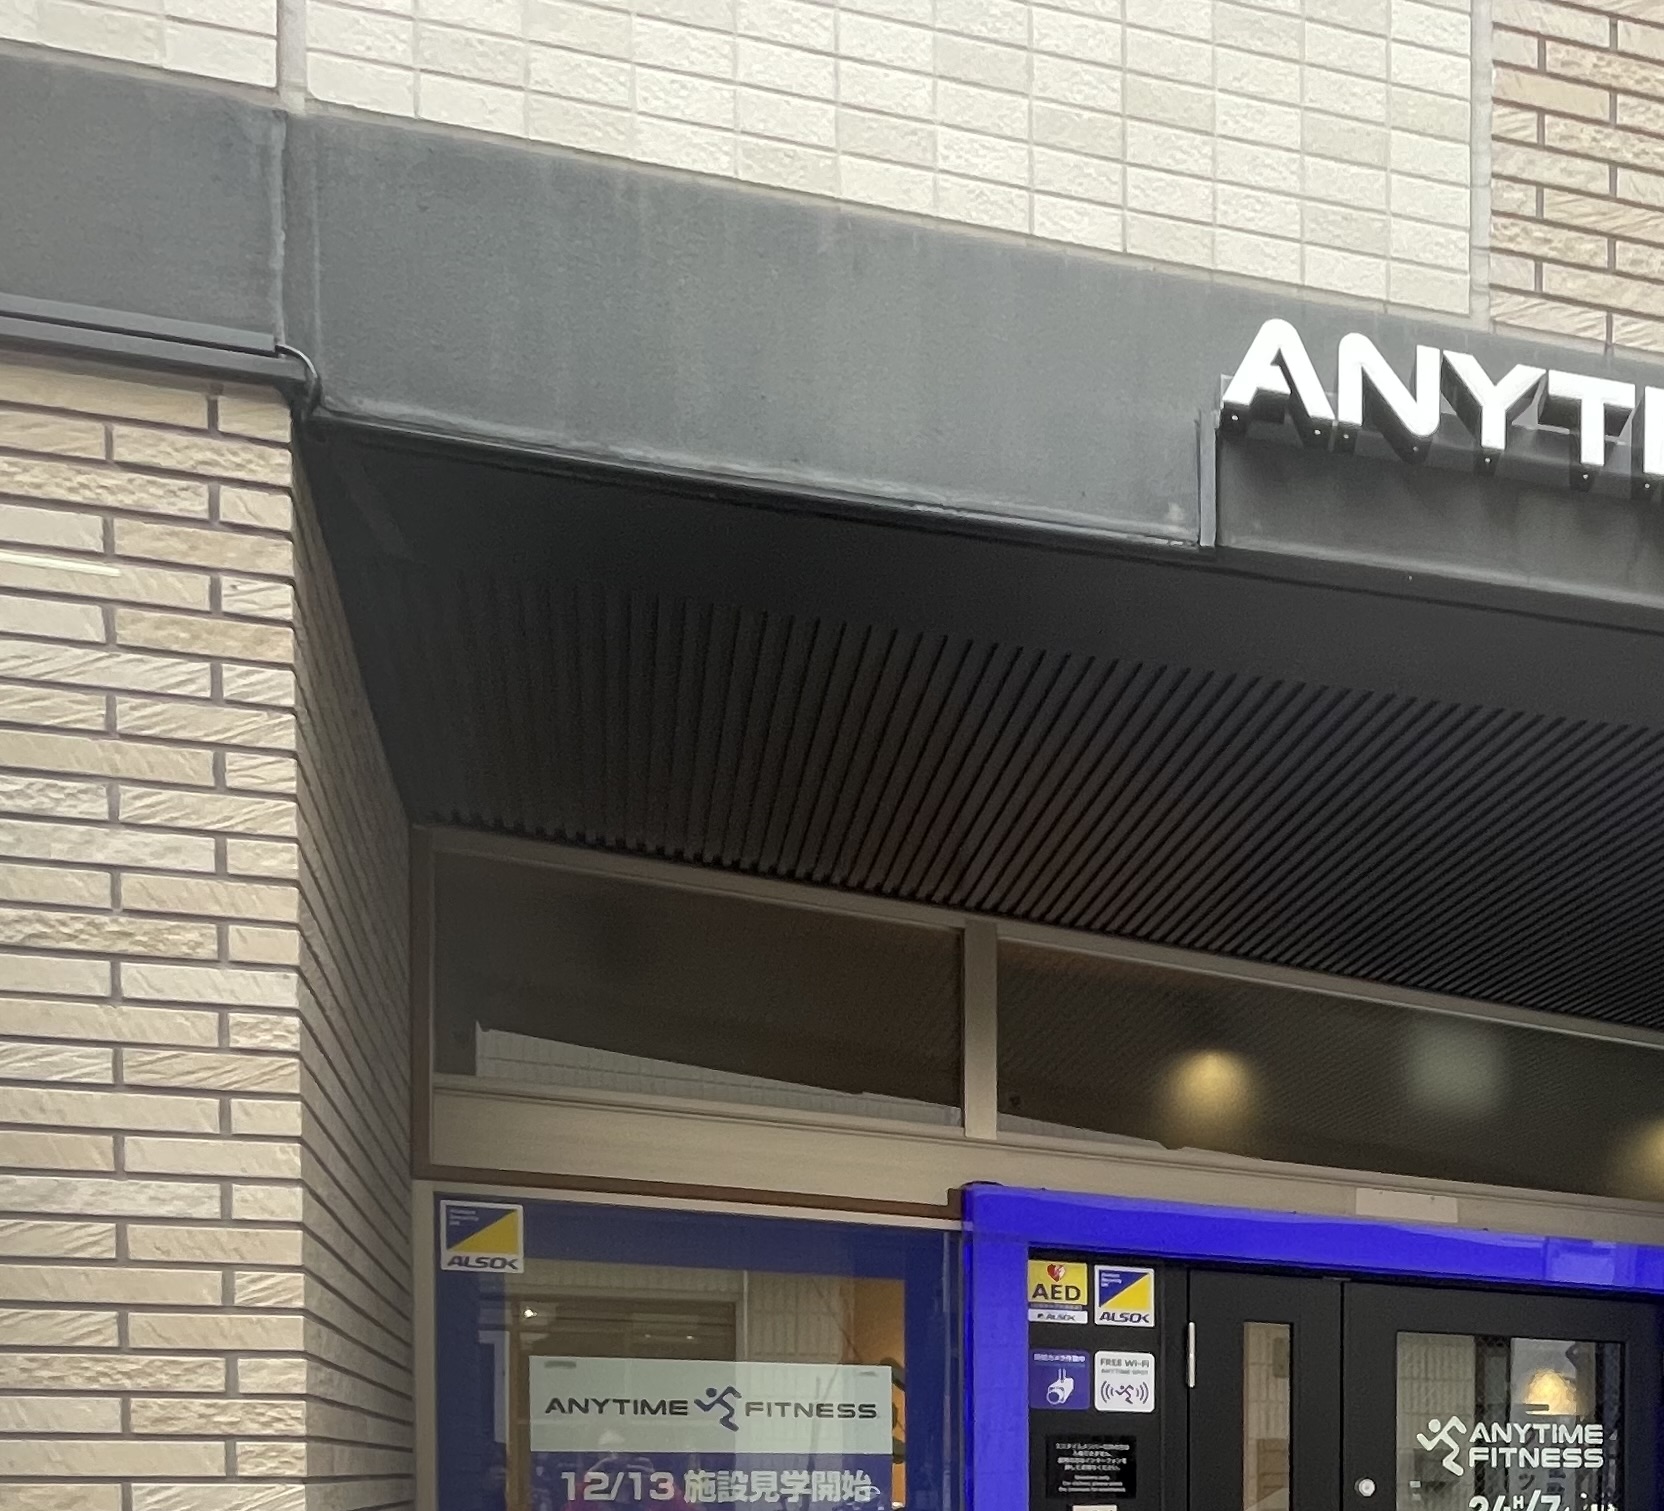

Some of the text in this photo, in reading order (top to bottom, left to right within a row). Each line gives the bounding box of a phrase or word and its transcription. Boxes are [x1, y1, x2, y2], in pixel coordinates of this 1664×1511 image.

[447, 1255, 518, 1270] ALSOK
[1031, 1283, 1081, 1301] AED
[1100, 1311, 1150, 1324] ALSOK
[1100, 1358, 1122, 1367] FREE
[545, 1397, 878, 1419] ANYTIME FITNESS
[1469, 1422, 1604, 1444] ANYTIME
[1468, 1447, 1604, 1468] FITNESS
[560, 1469, 872, 1504] 12/13 施設見学開始
